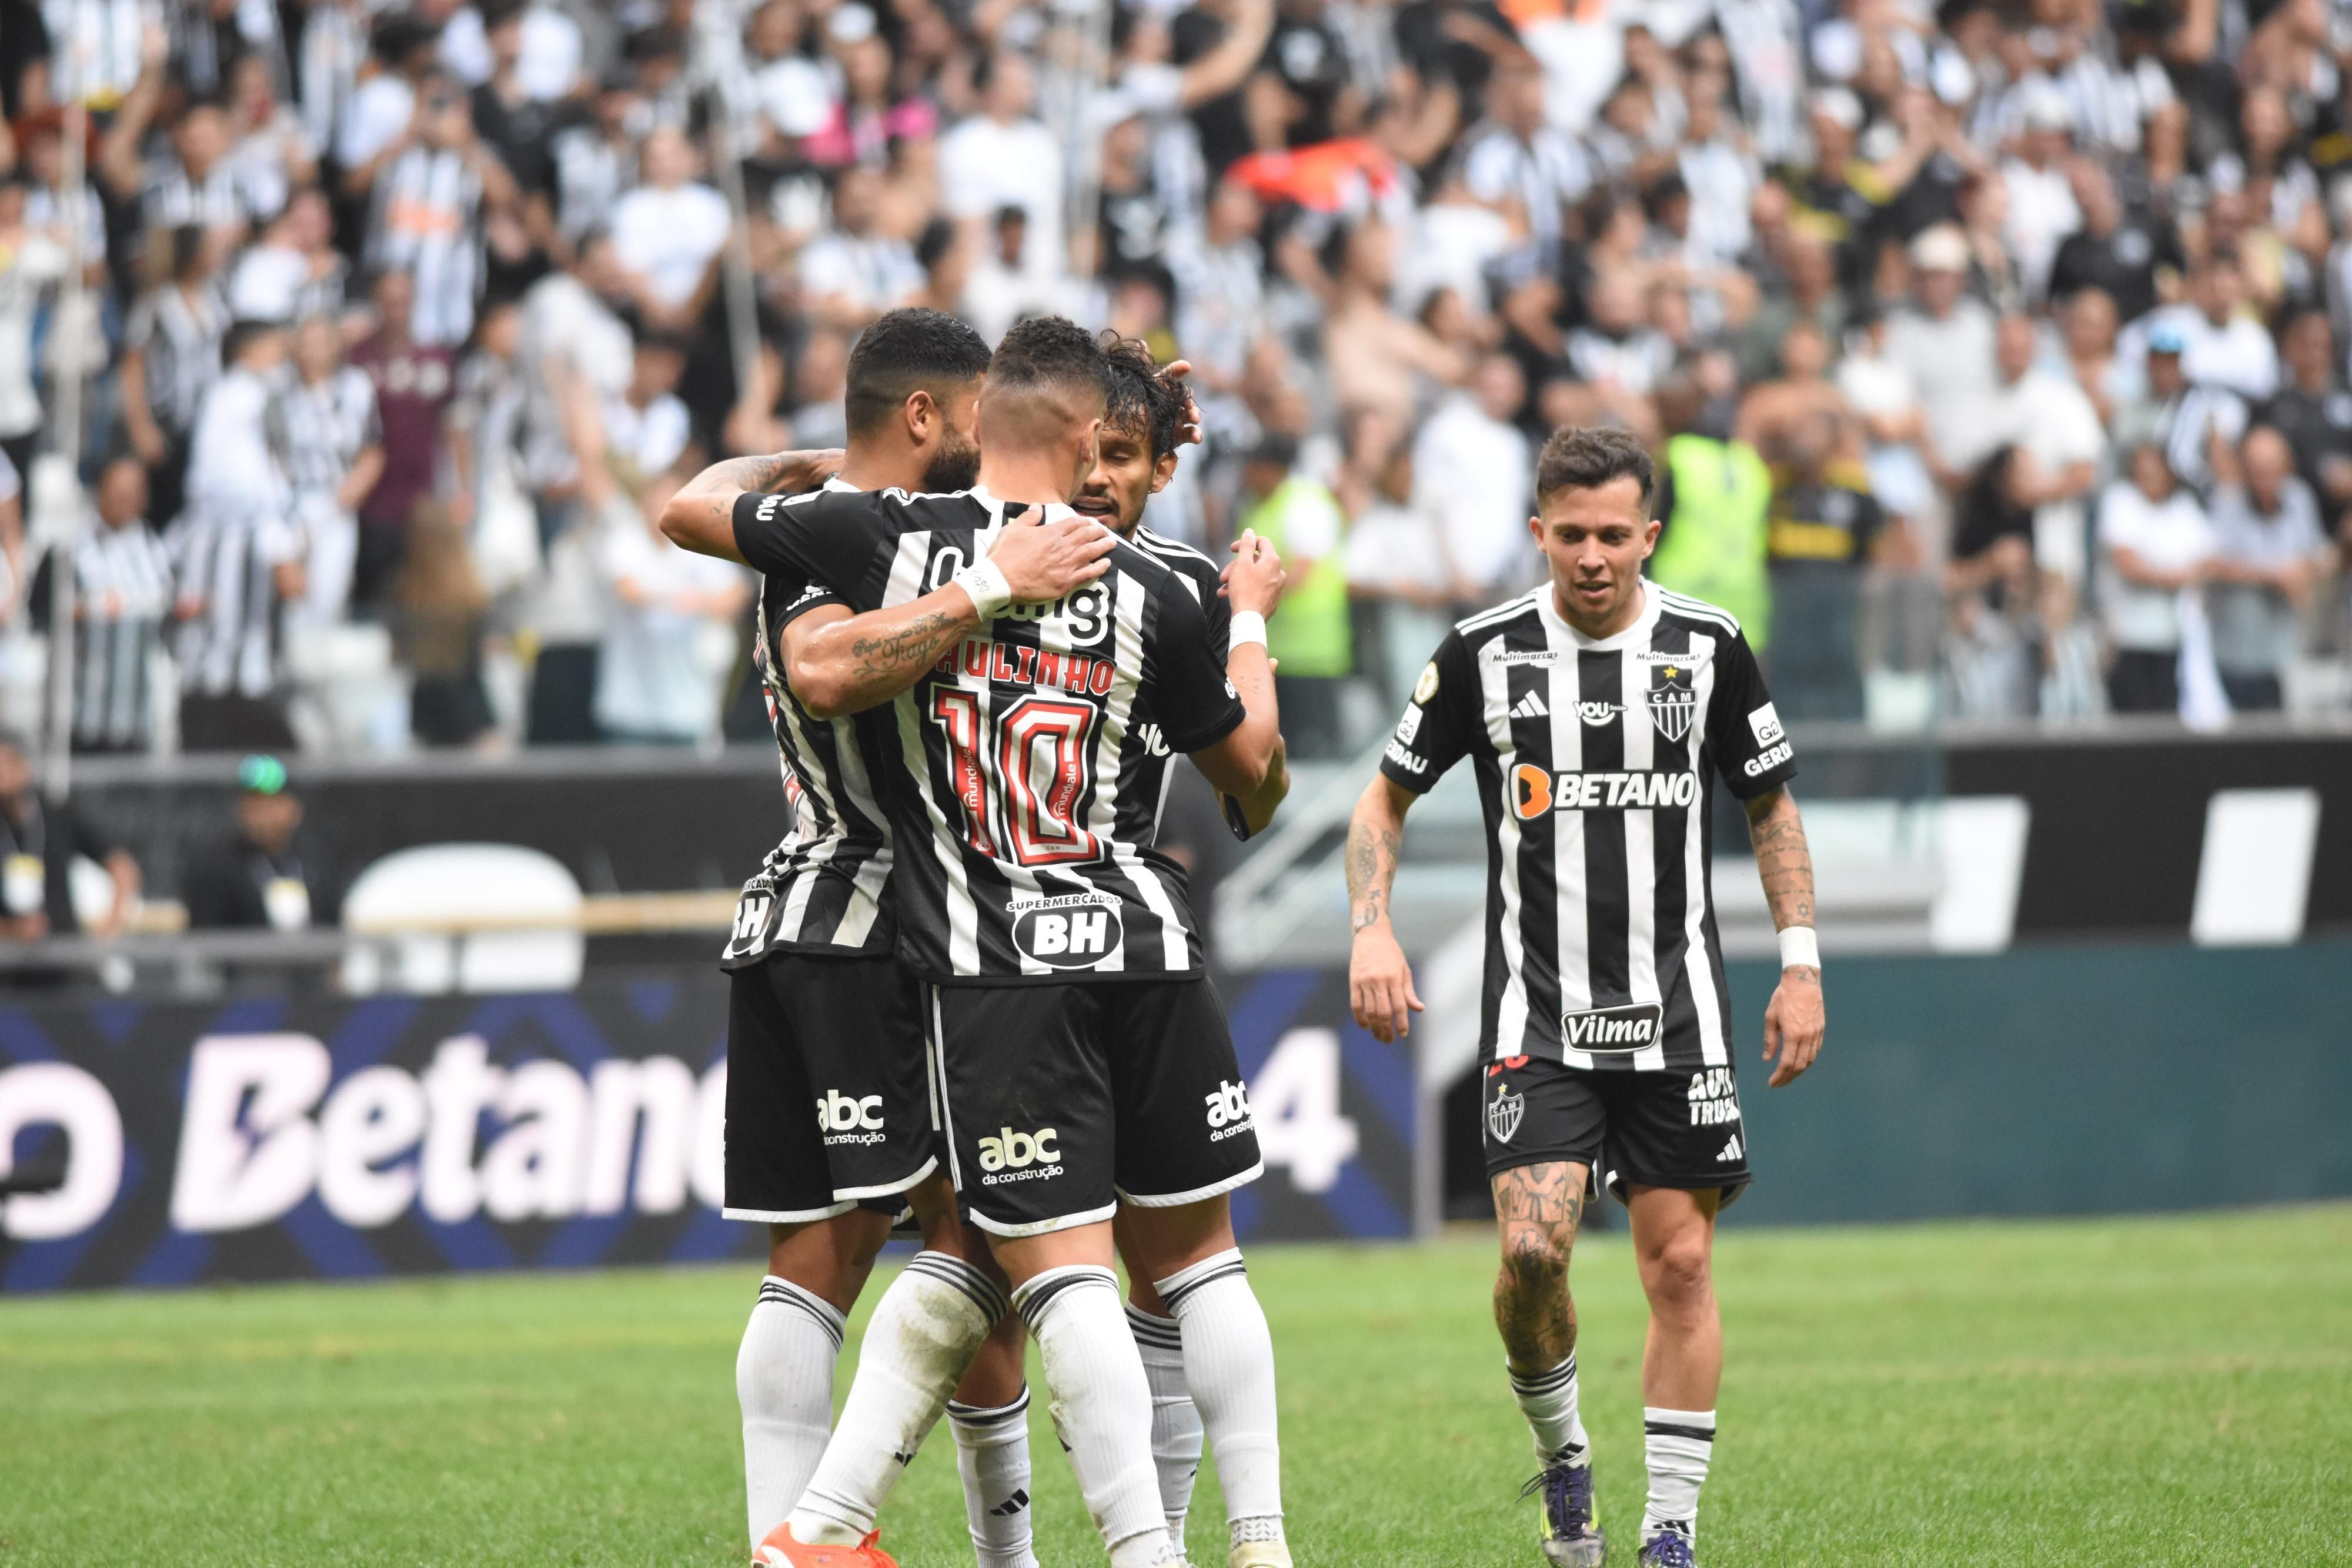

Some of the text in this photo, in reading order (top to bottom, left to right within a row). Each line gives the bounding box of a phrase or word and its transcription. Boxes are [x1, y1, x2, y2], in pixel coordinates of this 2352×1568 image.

[936, 639, 1115, 696] AULINHO
[1492, 651, 1558, 664] Multimarcas
[1636, 652, 1701, 662] Multimarcas
[1573, 701, 1609, 717] YOU
[1652, 692, 1692, 704] CAM
[1744, 740, 1793, 777] GERD
[929, 682, 1105, 867] 10
[963, 749, 978, 808] mundiale
[1554, 772, 1696, 807] BETANO
[1053, 763, 1077, 817] mundiale
[1007, 894, 1122, 911] SUPERMERCADOS
[1034, 912, 1108, 955] BH
[1567, 1015, 1653, 1045] Vilma
[1492, 1101, 1516, 1114] CAM
[169, 1032, 727, 1233] Betan
[824, 1131, 886, 1146] onstrução
[1210, 1129, 1224, 1142] da
[978, 1126, 1061, 1172] abc
[982, 1164, 1064, 1186] da construção
